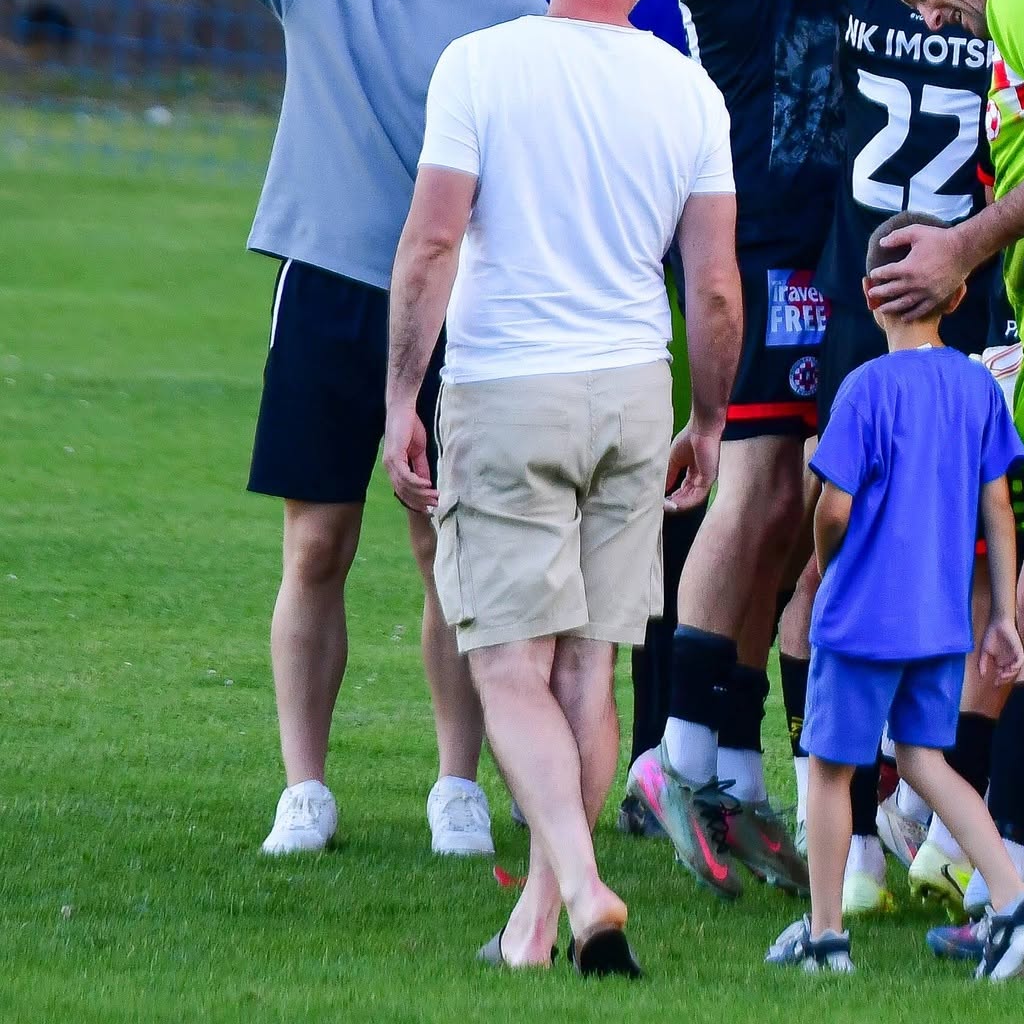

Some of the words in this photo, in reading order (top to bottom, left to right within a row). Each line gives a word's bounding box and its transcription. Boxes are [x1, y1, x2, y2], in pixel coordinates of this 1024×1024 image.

[845, 14, 879, 53] NK
[852, 67, 982, 222] 22
[771, 279, 825, 303] Trave
[770, 304, 827, 334] FREE
